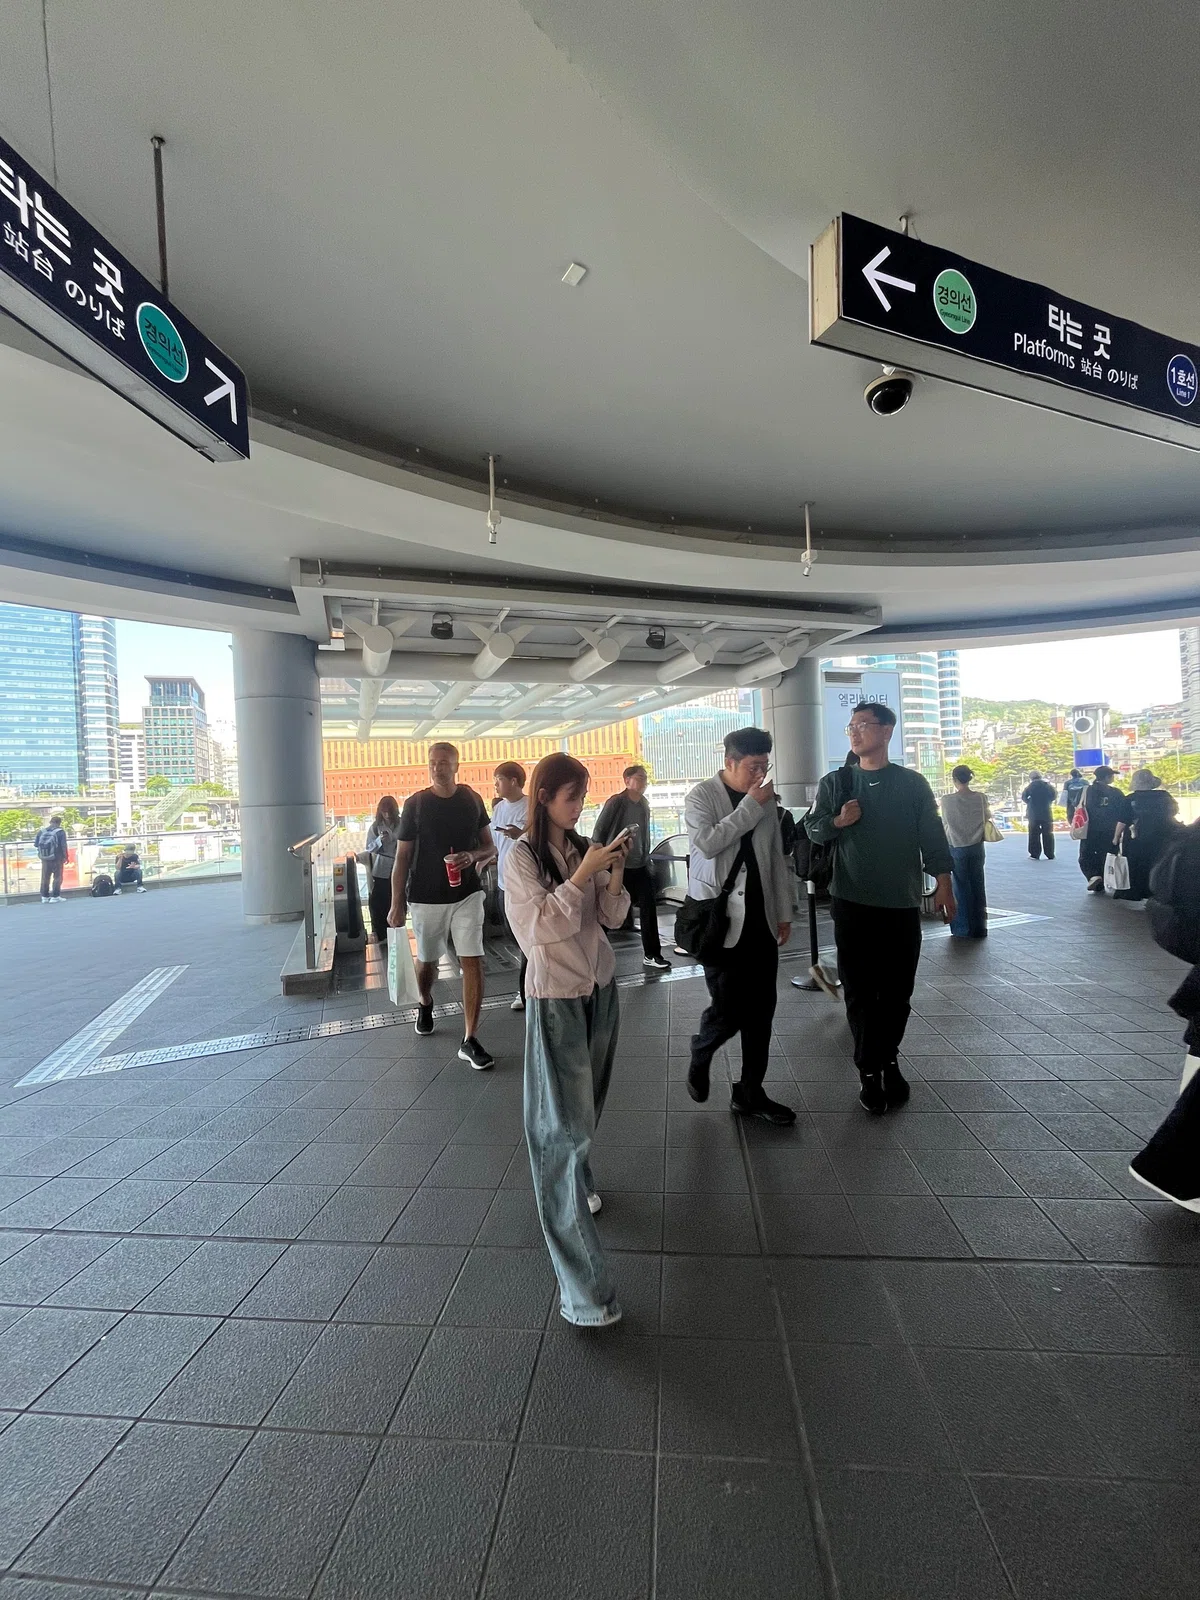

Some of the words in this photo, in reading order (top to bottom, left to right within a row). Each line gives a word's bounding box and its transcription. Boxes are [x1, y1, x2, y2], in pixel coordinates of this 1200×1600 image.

[0, 158, 71, 266] 타는
[93, 247, 124, 313] 곳
[3, 221, 54, 282] 站台
[65, 279, 126, 341] のりば
[937, 285, 972, 314] 경의선
[144, 317, 185, 369] 경의선
[1048, 303, 1083, 350] 타는
[1093, 323, 1111, 360] 곳
[1014, 332, 1075, 370] Platforms
[1080, 357, 1103, 380] 站台
[1107, 368, 1139, 390] のりば
[1170, 366, 1195, 390] 1호선
